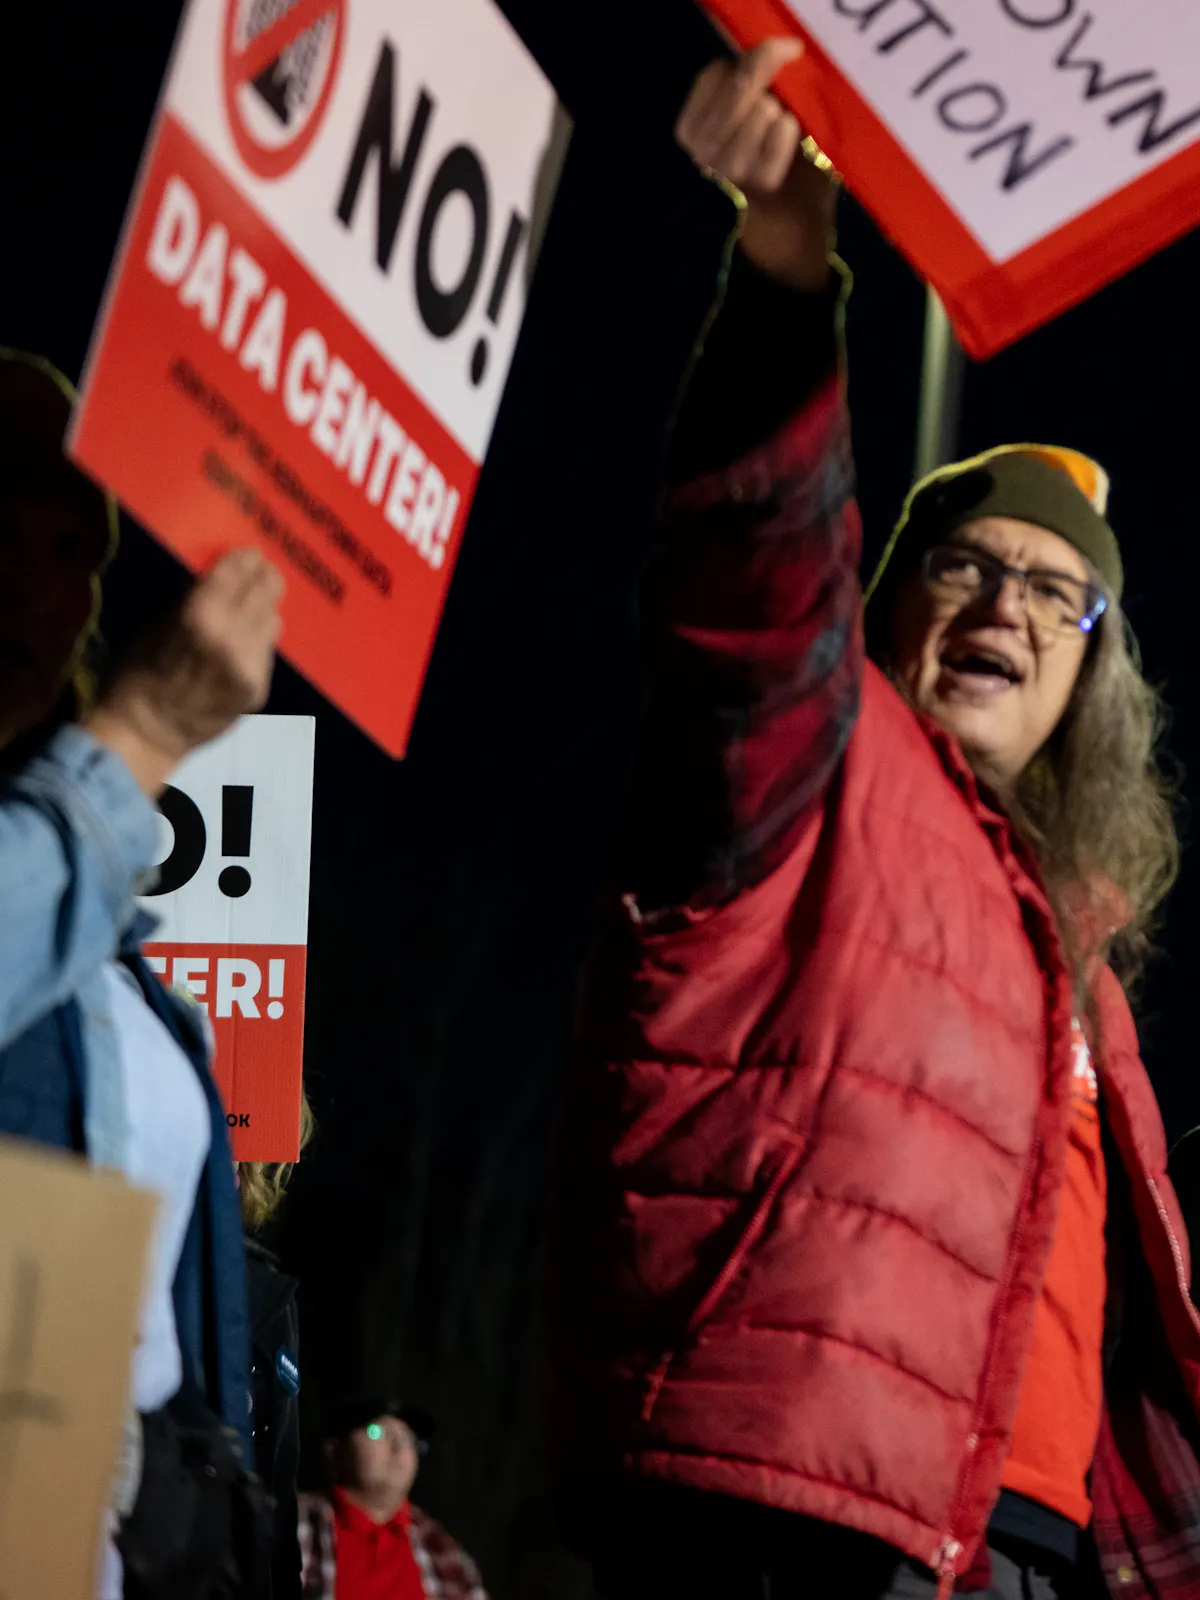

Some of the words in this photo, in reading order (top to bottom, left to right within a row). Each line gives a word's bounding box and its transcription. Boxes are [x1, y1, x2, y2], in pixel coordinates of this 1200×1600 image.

[146, 174, 286, 393] DATA
[283, 328, 460, 570] CENTER!
[335, 32, 529, 388] NO!
